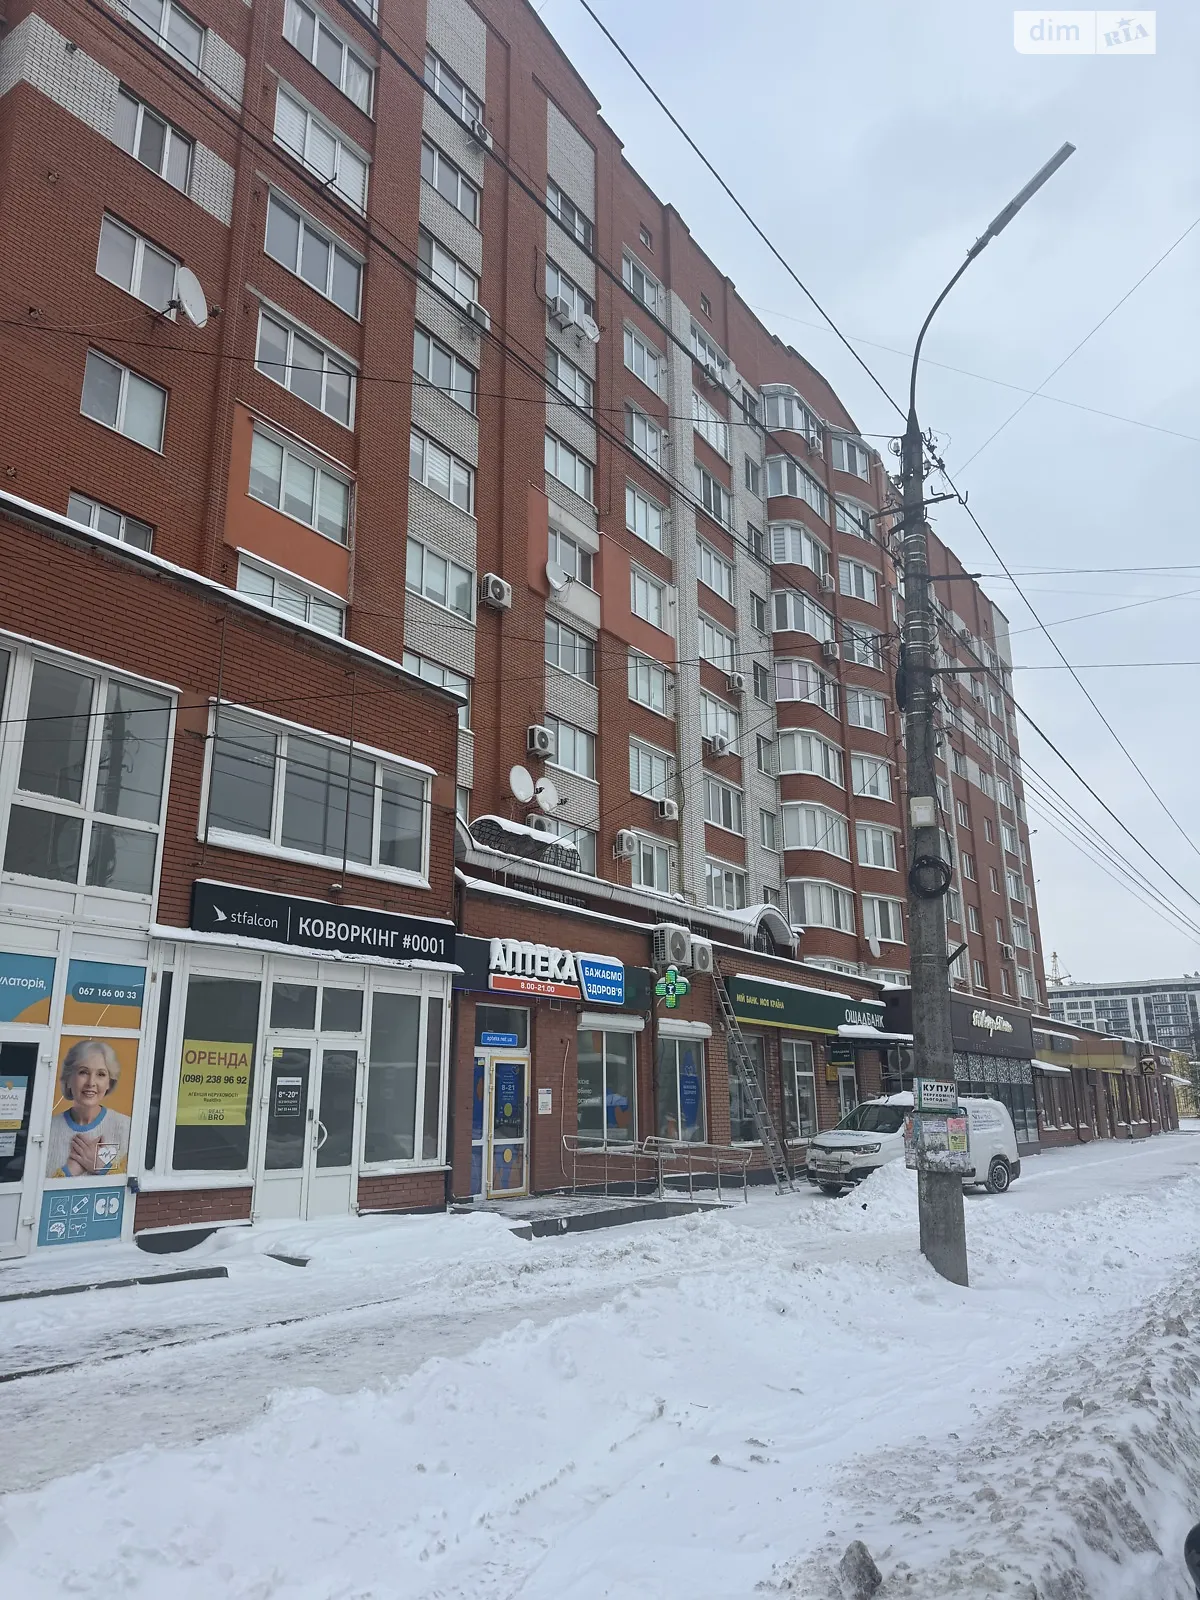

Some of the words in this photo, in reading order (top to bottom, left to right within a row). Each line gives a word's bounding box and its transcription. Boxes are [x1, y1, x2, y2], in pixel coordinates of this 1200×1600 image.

[230, 911, 278, 929] stfalcon
[298, 917, 399, 948] КОВОРКІНГ
[402, 934, 445, 955] #0001
[489, 938, 578, 982] АПТЕКА
[584, 967, 623, 981] БАЖАЄМО
[78, 986, 95, 997] 067
[97, 988, 112, 998] 166
[114, 990, 125, 999] 00
[126, 991, 137, 1000] 33
[520, 982, 555, 993] 8.00-21.00
[844, 1008, 885, 1028] ОЩАДБАНК
[185, 1050, 248, 1069] ОРЕНДА
[182, 1074, 204, 1085] (098)
[206, 1075, 222, 1084] 238
[223, 1076, 235, 1085] 96
[236, 1076, 247, 1085] 92
[923, 1083, 955, 1093] КУПУЙ
